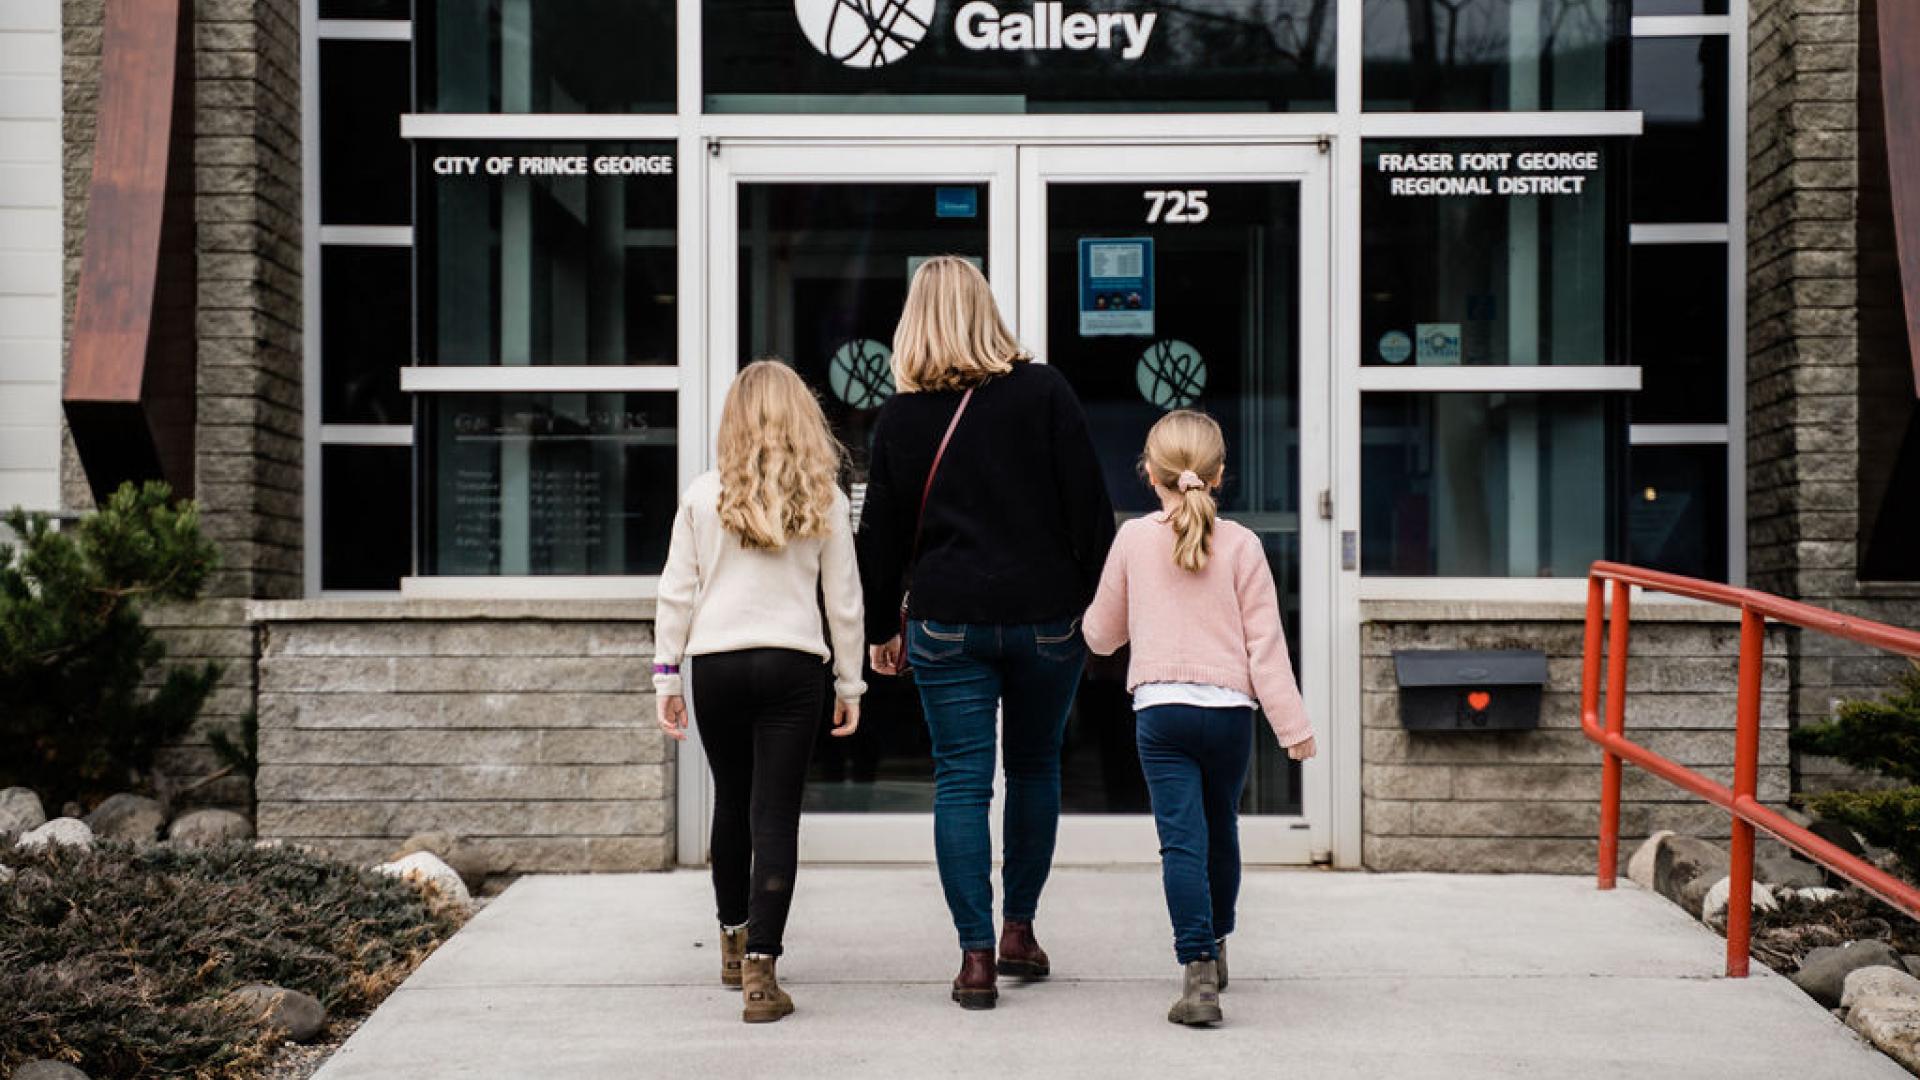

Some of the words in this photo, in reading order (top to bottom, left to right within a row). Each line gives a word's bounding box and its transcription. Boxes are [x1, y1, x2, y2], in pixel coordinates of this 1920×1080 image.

[956, 1, 1157, 59] Gallery
[434, 157, 479, 174] CITY
[486, 157, 512, 174] OF
[520, 157, 587, 174] PRINCE
[594, 157, 672, 174] GEORGE
[1380, 153, 1453, 170] FRASER
[1461, 153, 1511, 170] FORT
[1517, 153, 1597, 170] GEORGE
[1391, 177, 1491, 194] REGIONAL
[1498, 176, 1584, 194] DISTRICT
[1144, 191, 1208, 222] 725
